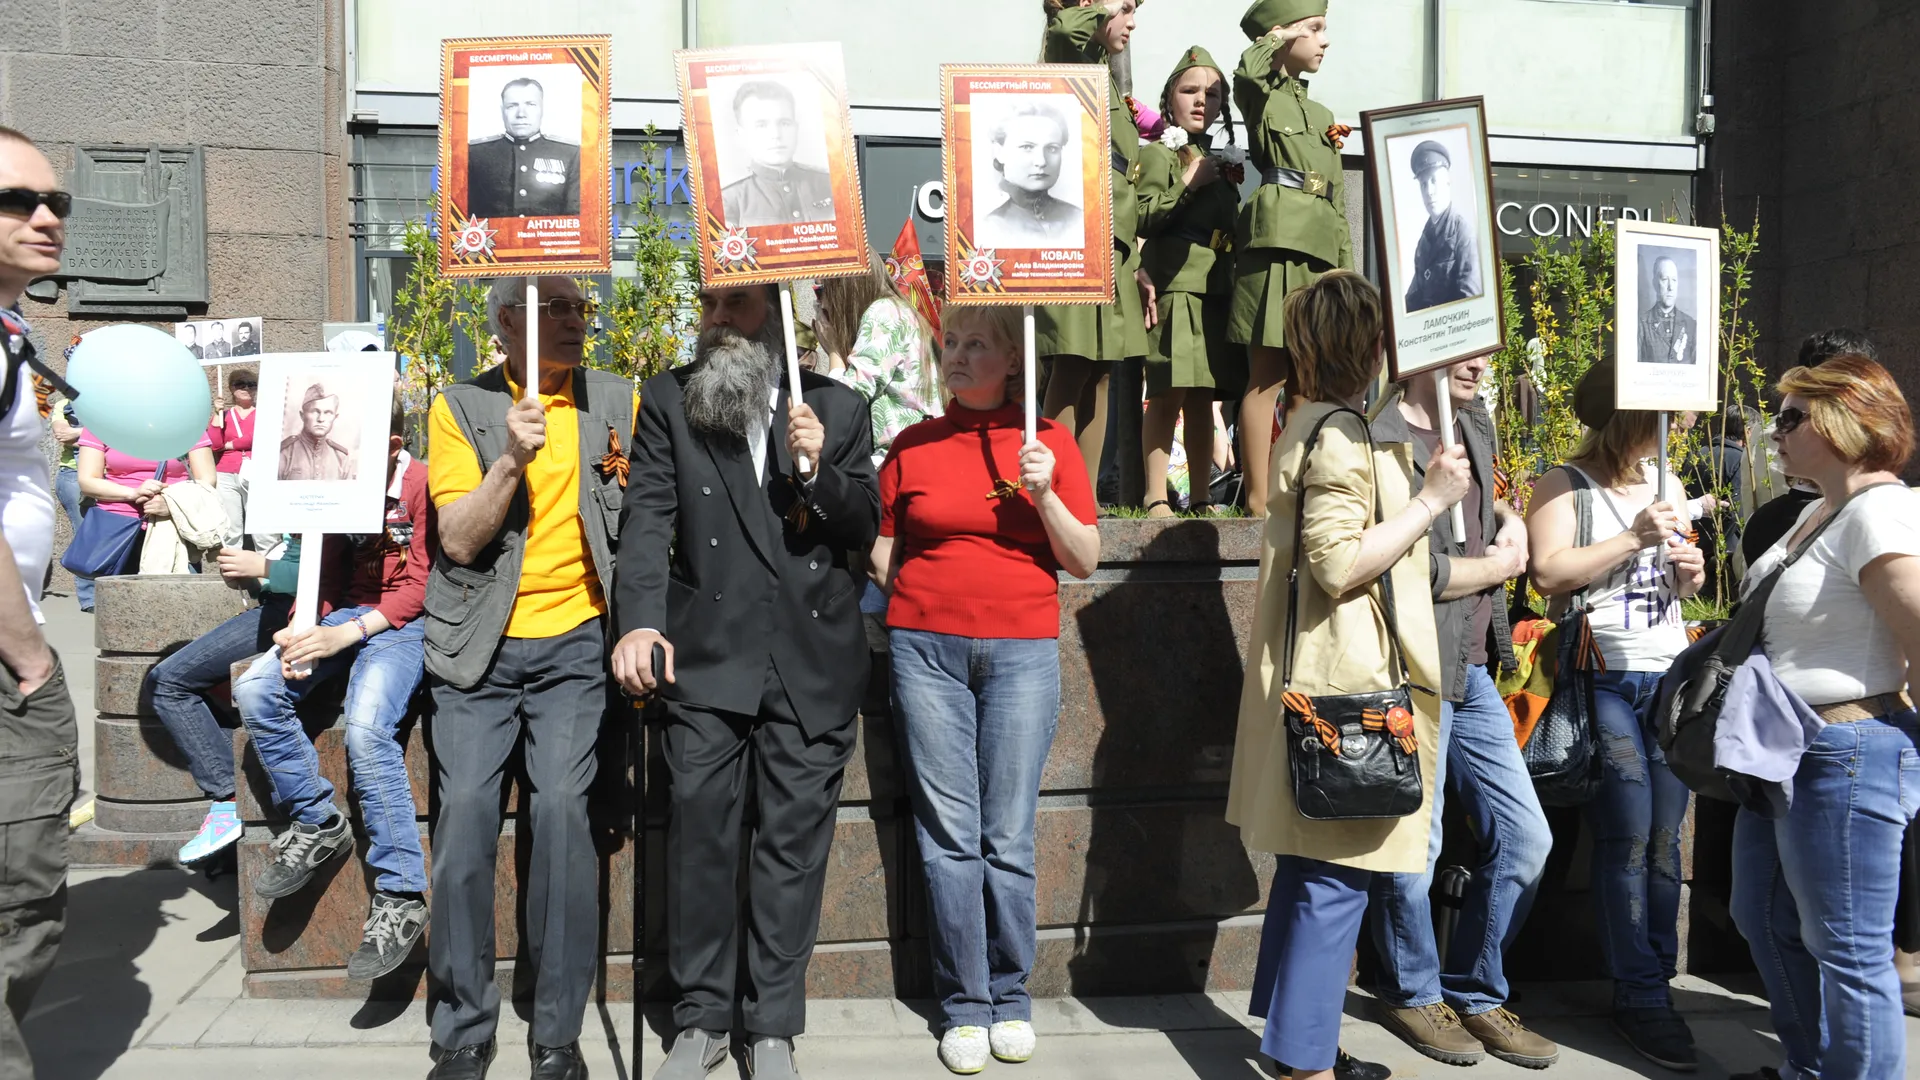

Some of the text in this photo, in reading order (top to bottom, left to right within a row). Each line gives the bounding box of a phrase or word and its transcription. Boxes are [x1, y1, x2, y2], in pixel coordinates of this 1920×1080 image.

[469, 53, 553, 63] БЕССМЕРТНЫЙ ПОЛК
[969, 81, 1052, 90] БЕССМЕРТНЫЙ ПОЛК
[527, 218, 580, 230] АНТУШЕВ
[793, 223, 837, 236] КОВАЛЬ
[75, 247, 158, 257] ВАСИЛЬЕВИЧ
[1041, 250, 1085, 261] КОВАЛЬ
[68, 258, 159, 269] ВАСИЛЬЕВ
[1423, 309, 1470, 331] ЛАМОЧКИН
[1397, 316, 1495, 349] Константин Тимофеевич
